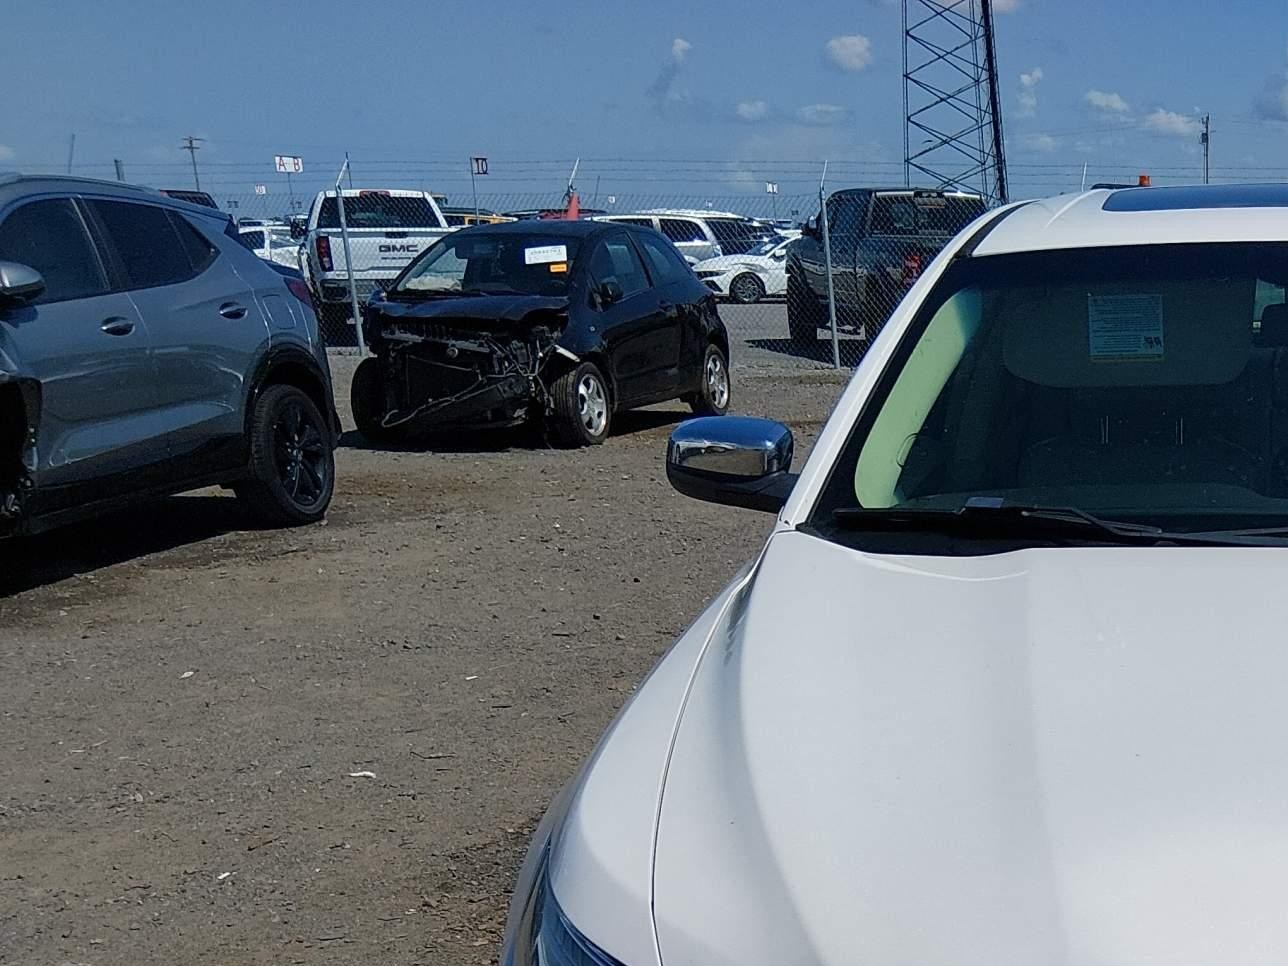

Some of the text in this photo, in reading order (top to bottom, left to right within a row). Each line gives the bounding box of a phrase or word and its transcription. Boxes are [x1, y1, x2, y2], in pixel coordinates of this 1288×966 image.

[278, 157, 301, 171] A B
[378, 244, 419, 253] GMC
